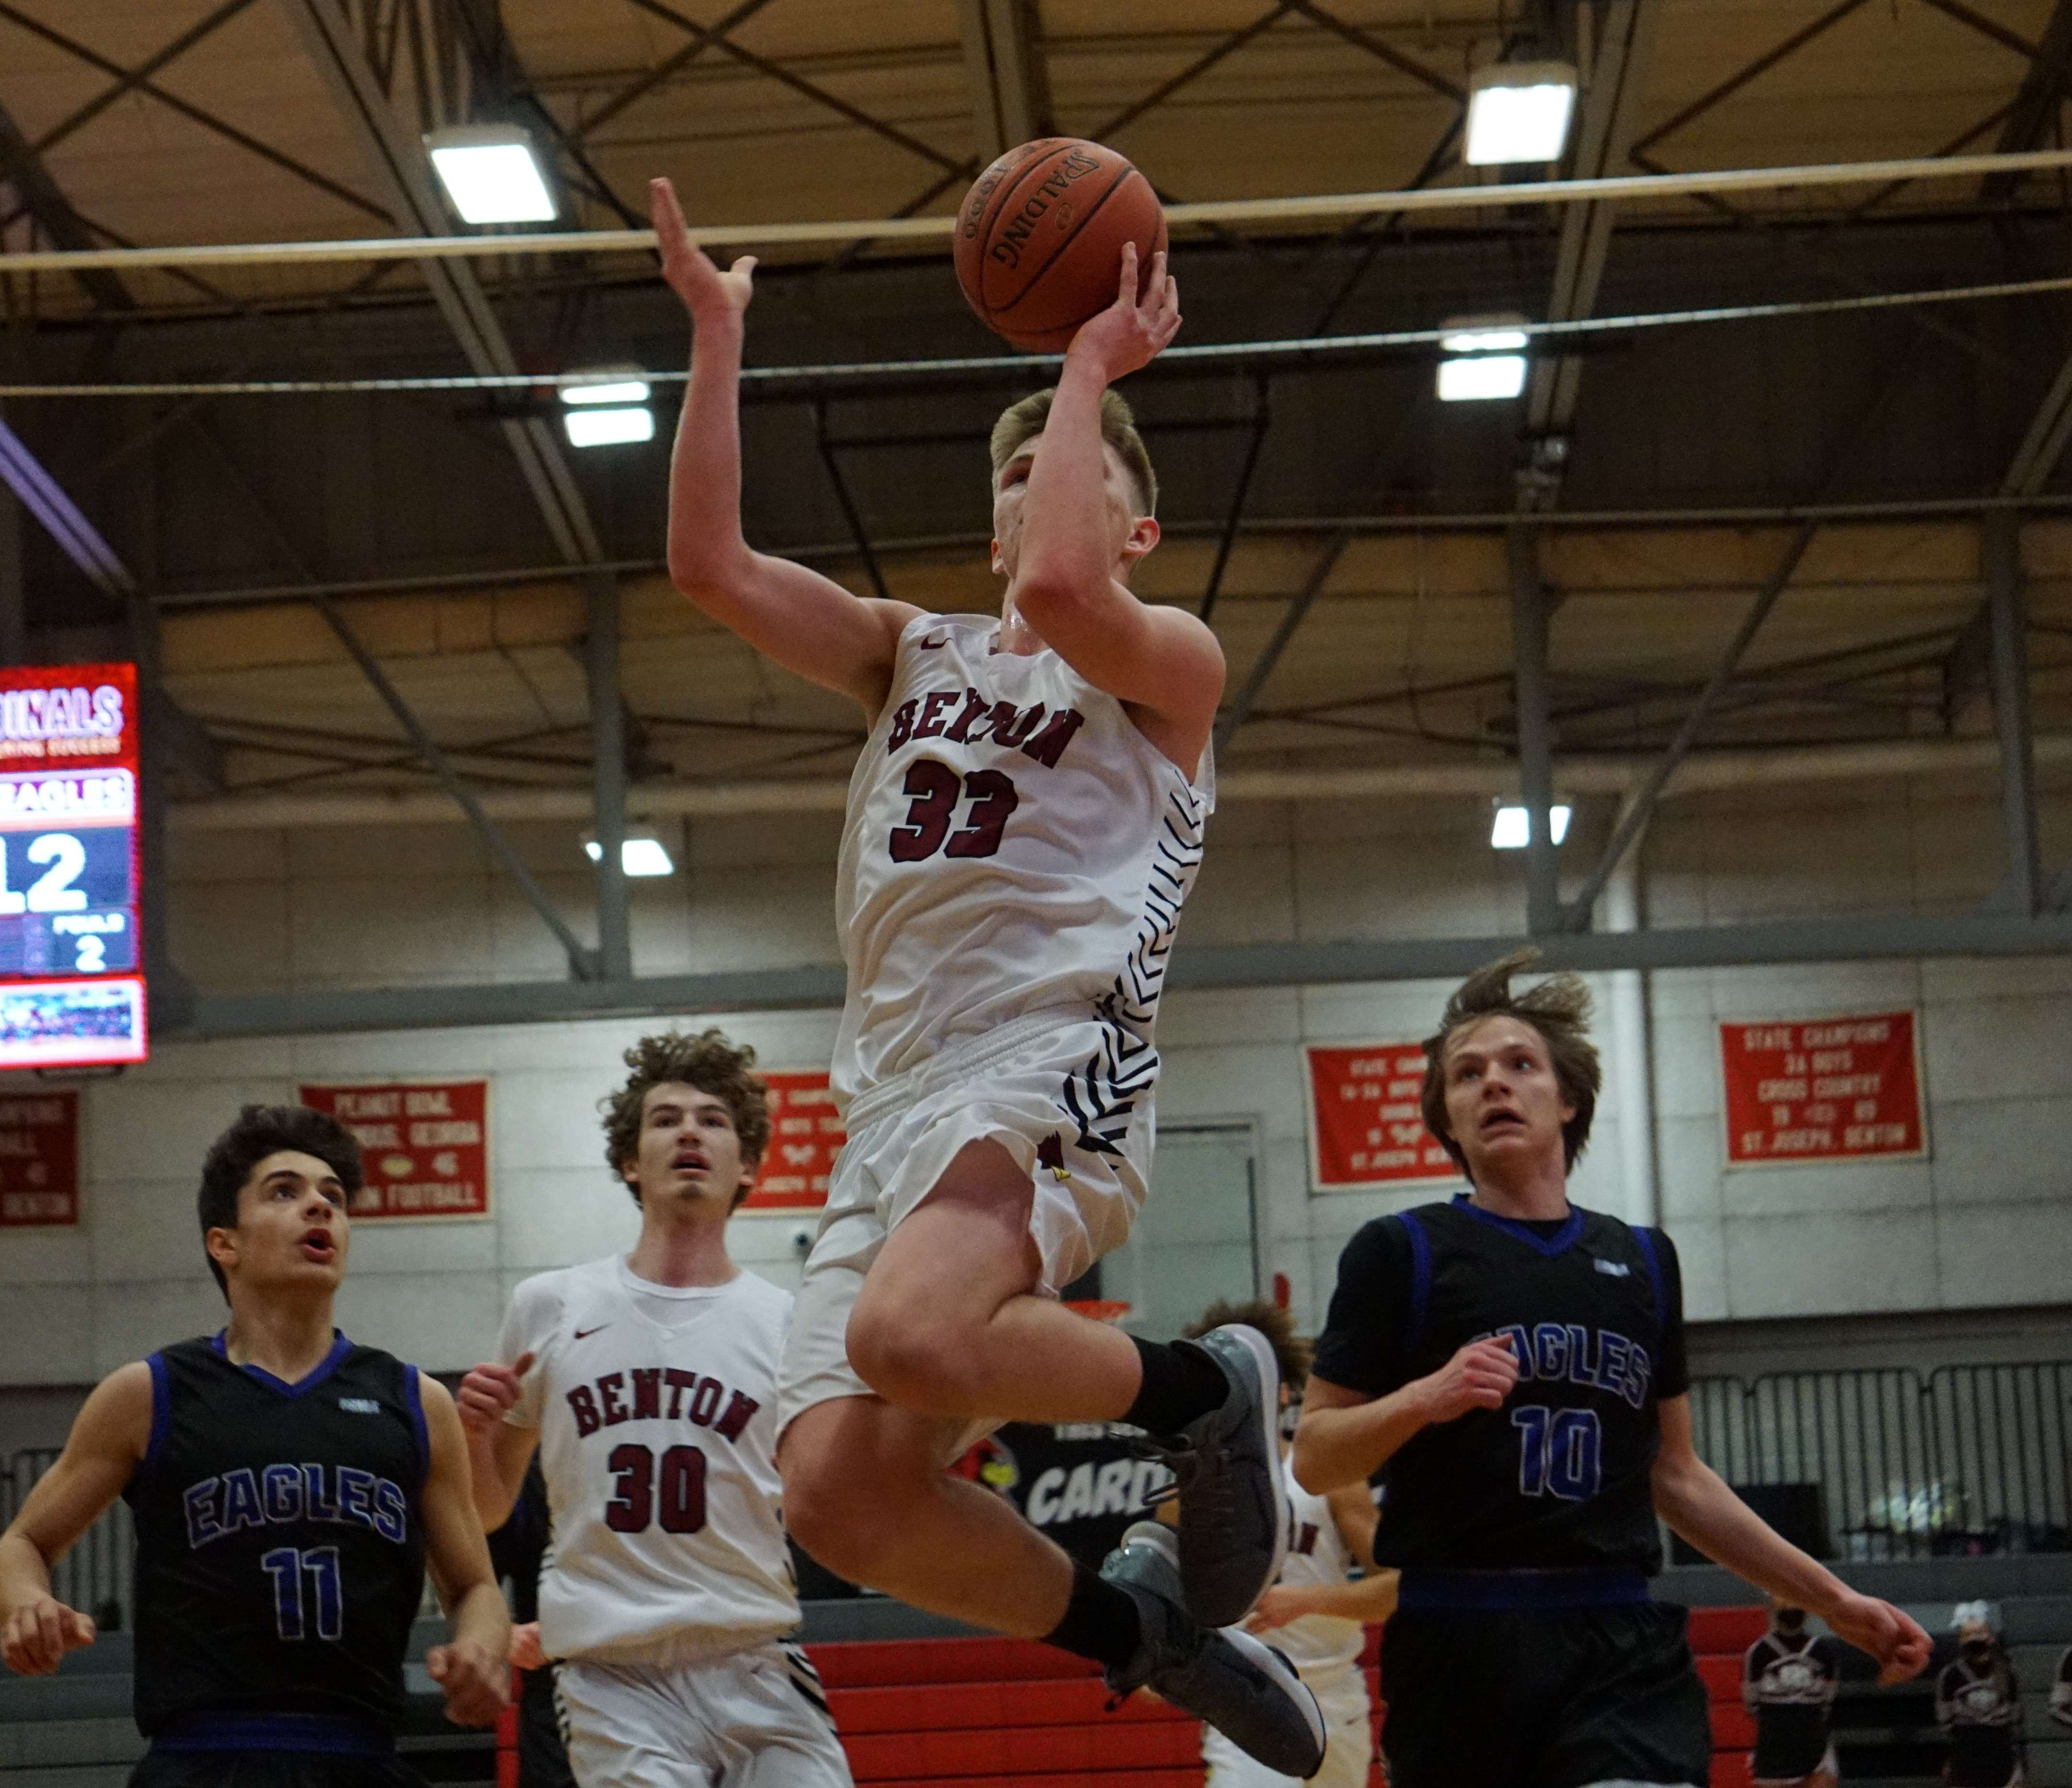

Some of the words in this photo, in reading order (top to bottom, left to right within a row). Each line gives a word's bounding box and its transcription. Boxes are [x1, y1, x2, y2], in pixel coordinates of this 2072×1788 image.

[991, 149, 1100, 270] SPALDING
[0, 684, 125, 742] INALS
[889, 759, 1019, 863] 33
[75, 935, 105, 972] 2
[565, 1368, 760, 1444] BENTON
[1466, 1322, 1651, 1409] AGLES
[605, 1443, 707, 1534] 30
[1026, 1458, 1177, 1527] CARD
[1510, 1405, 1602, 1501] 10
[183, 1463, 407, 1550] EAGLES
[260, 1546, 343, 1641] 11
